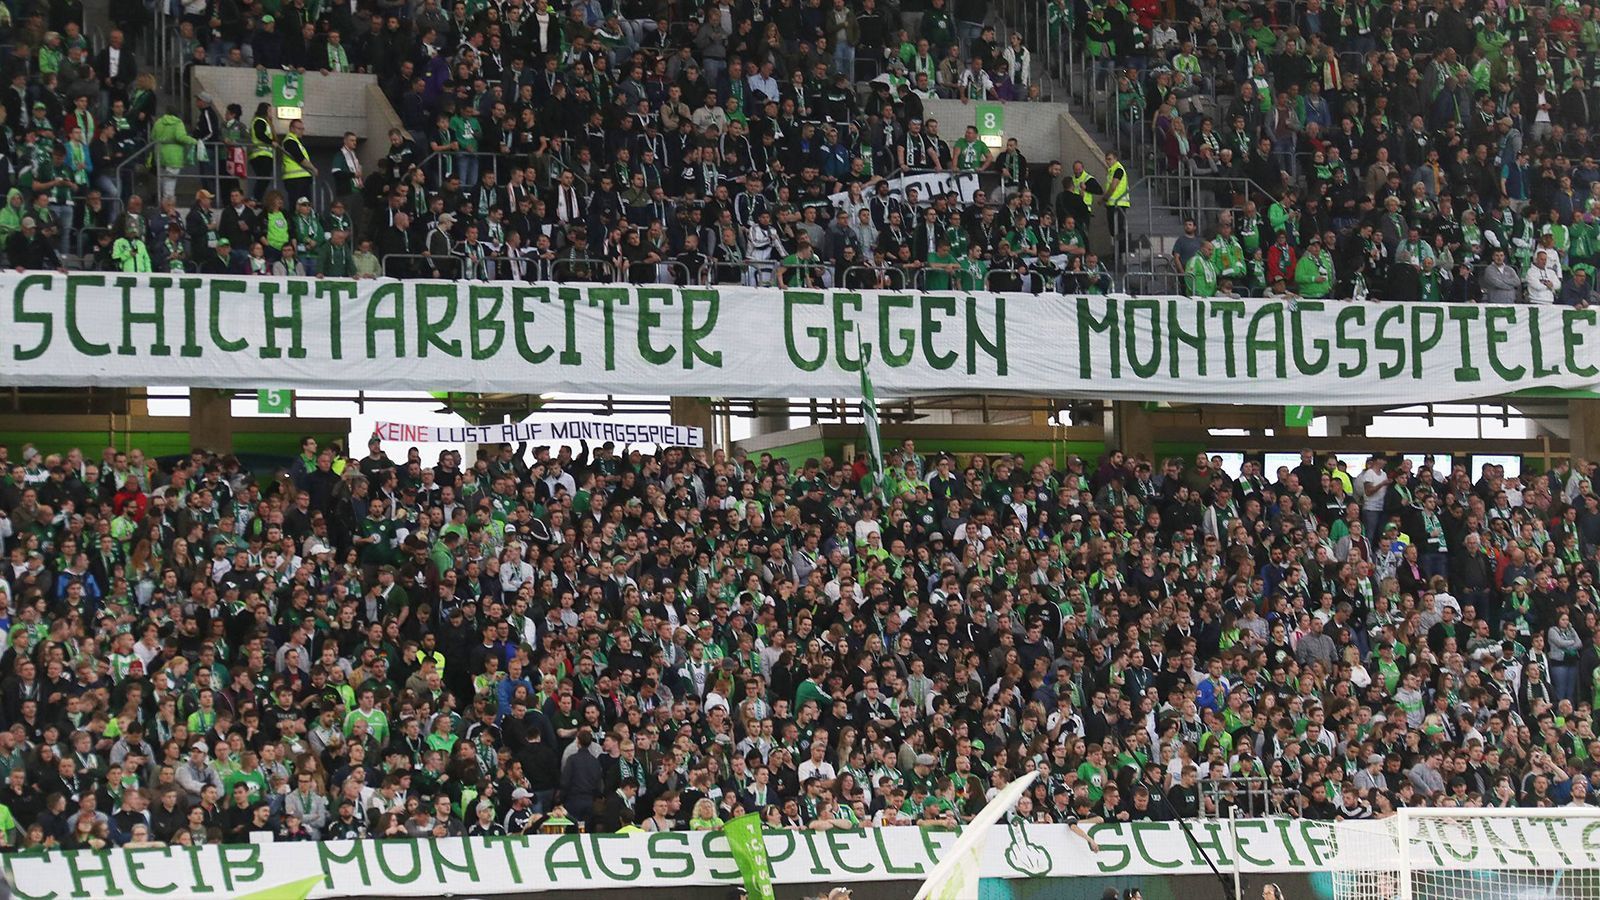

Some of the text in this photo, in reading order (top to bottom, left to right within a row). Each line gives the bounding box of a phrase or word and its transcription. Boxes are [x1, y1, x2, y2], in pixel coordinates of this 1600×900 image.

[984, 112, 996, 129] 8
[13, 275, 1599, 382] SCHICHTARBEITER GEGEN MONTAGSSPIELE
[267, 388, 281, 406] 5
[375, 422, 698, 446] KEINE LUST AUF MONTAGSSPIELE
[319, 825, 961, 889] MONTAGSSPIELE
